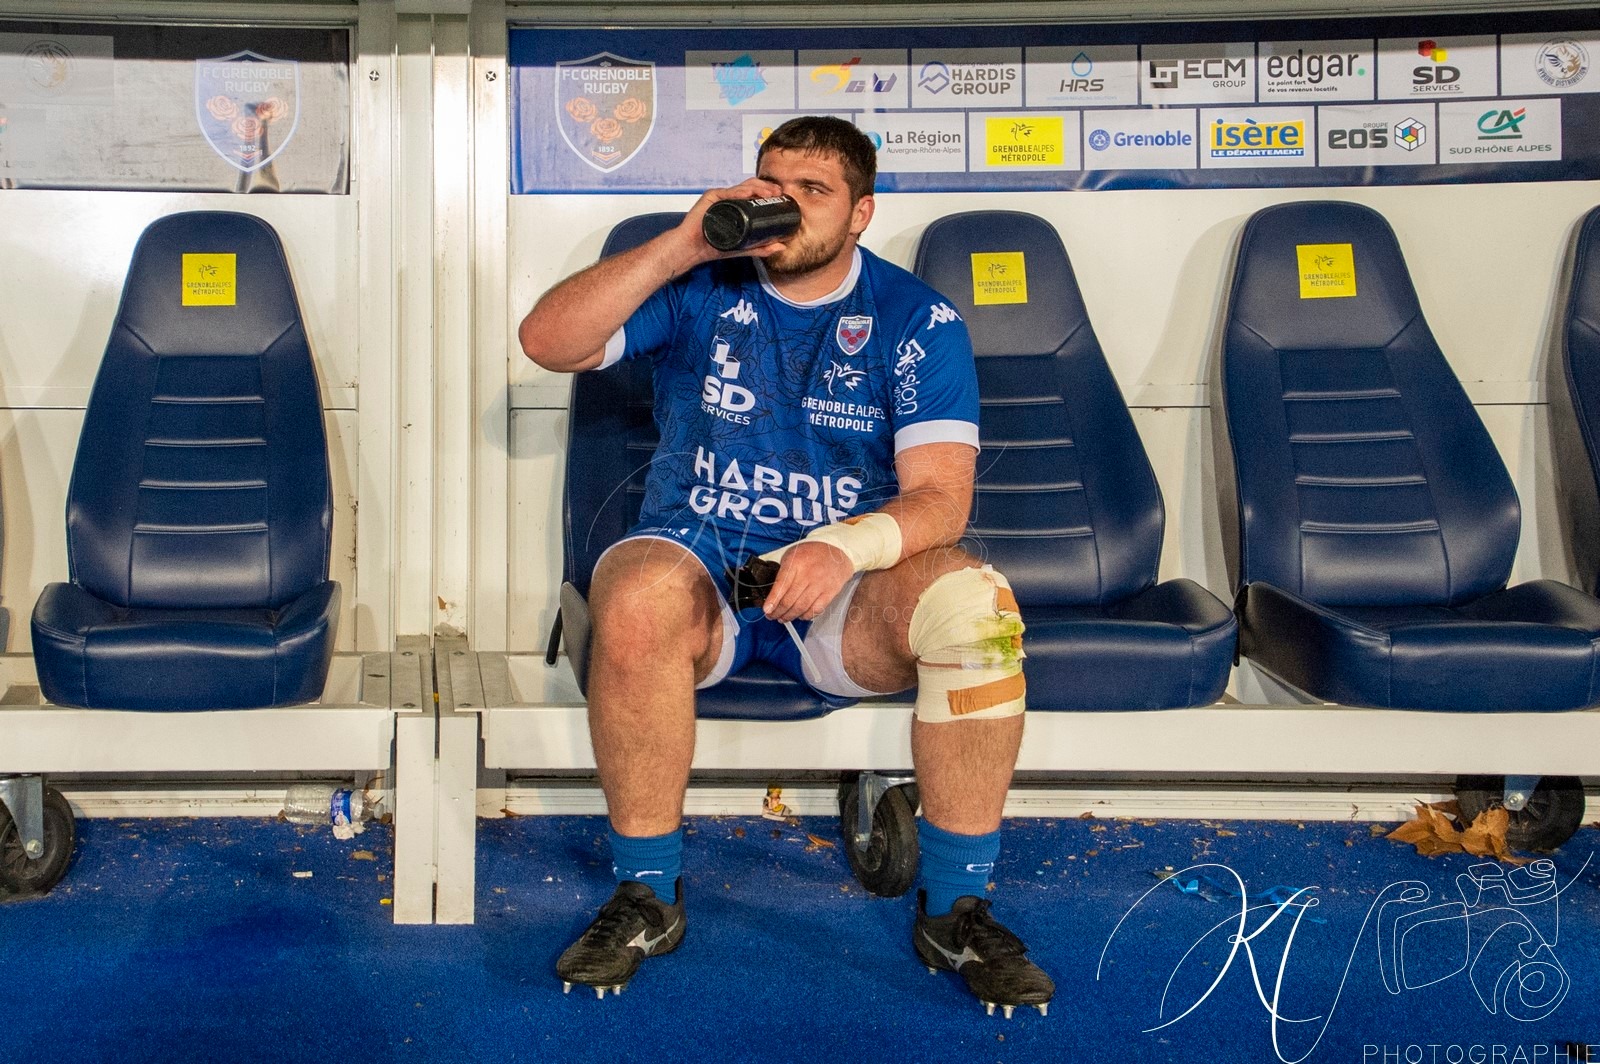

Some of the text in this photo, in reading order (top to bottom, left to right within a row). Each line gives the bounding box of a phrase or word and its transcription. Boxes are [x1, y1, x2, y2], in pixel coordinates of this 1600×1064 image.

[222, 67, 294, 80] GRENOBLE
[580, 68, 651, 81] GRENOBLE
[951, 68, 1016, 81] HARDIS
[1183, 58, 1246, 79] ECM
[1412, 66, 1461, 85] SD
[224, 81, 270, 93] RUGBY
[584, 82, 629, 95] RUGBY
[951, 82, 1011, 95] GROUP
[1060, 78, 1104, 93] HRS
[1212, 80, 1247, 88] GROUP
[1276, 79, 1293, 87] point
[1412, 83, 1461, 93] SERVICES
[1362, 121, 1388, 129] GROUPE
[886, 130, 961, 147] La Région
[1215, 117, 1299, 147] isère
[1328, 128, 1388, 149] eos
[1113, 130, 1192, 148] Grenoble
[598, 145, 615, 153] 1892
[886, 146, 962, 155] Auvergne-Rhône-Alpes
[1449, 143, 1552, 155] SUD RHÔNE ALPES
[1000, 152, 1046, 162] MÉTROPOLE
[702, 374, 756, 412] SD
[809, 411, 874, 433] MÉTROPOLE
[694, 445, 862, 509] HARDIS
